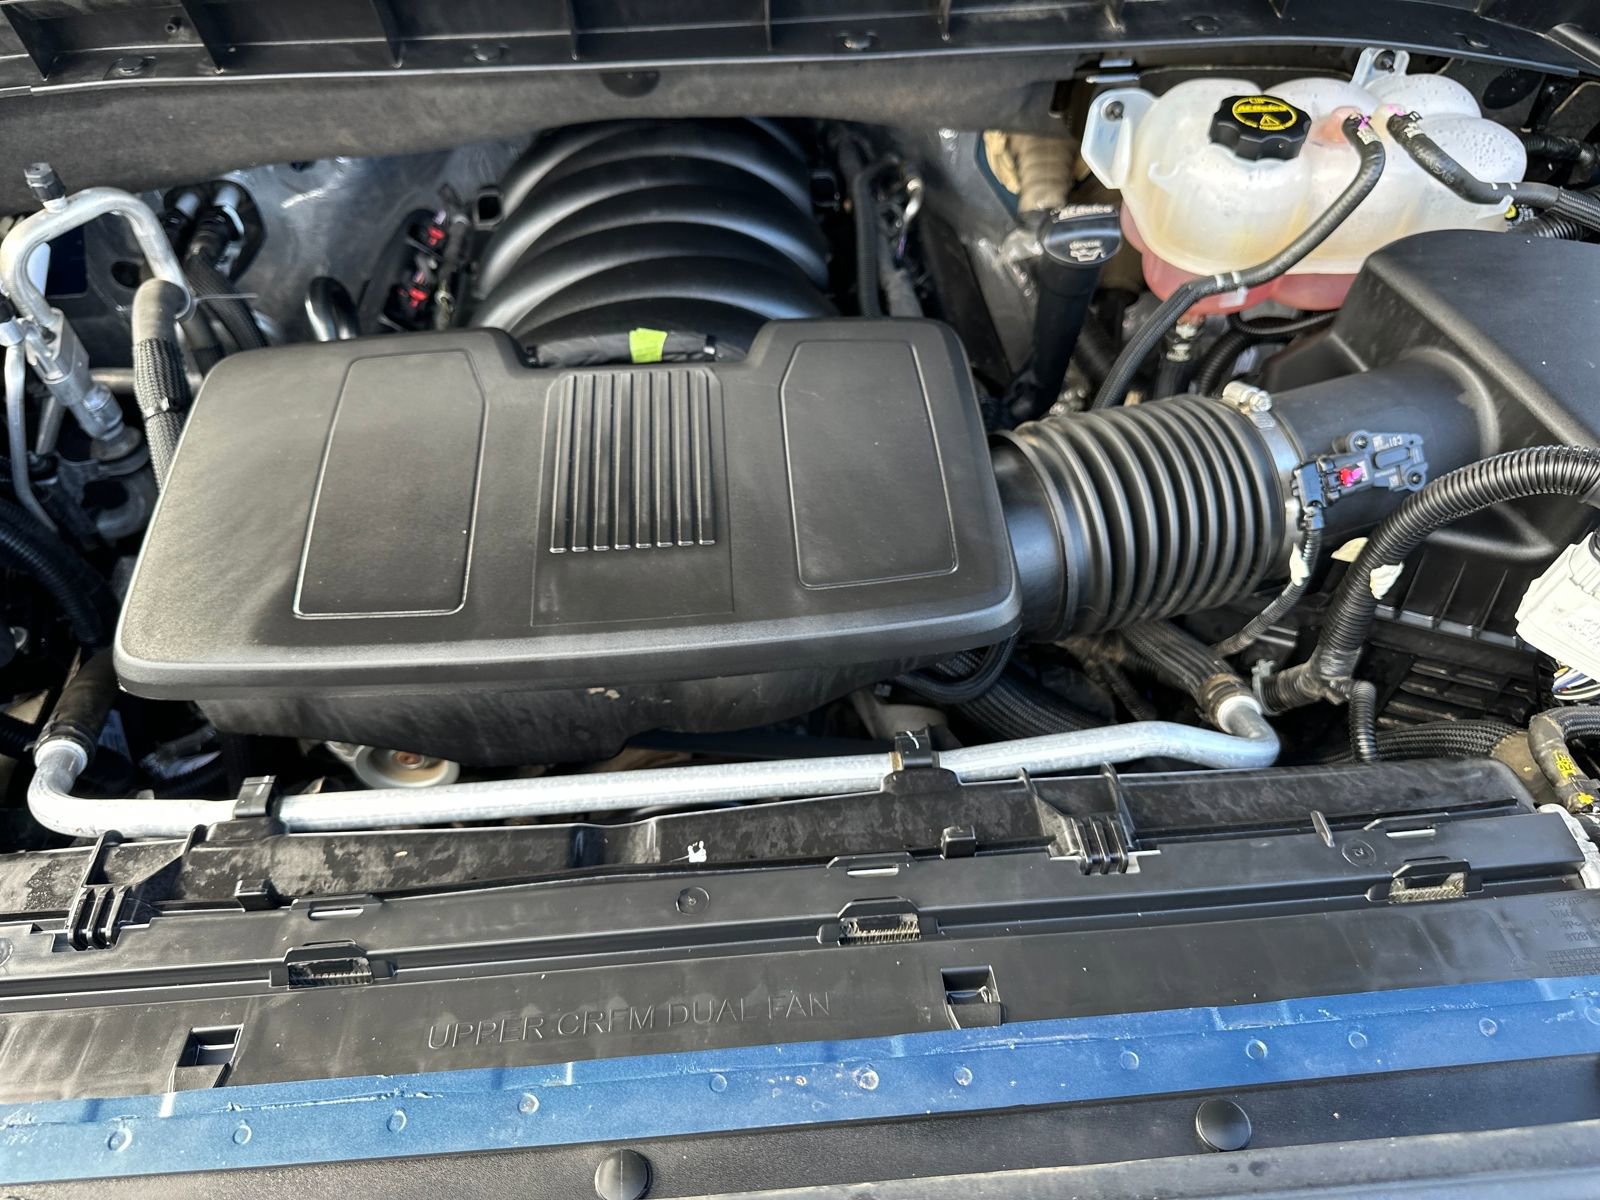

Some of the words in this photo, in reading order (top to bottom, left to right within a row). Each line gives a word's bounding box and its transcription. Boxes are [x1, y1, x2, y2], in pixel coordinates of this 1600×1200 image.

[428, 1017, 545, 1050] UPPER
[556, 1005, 656, 1036] CRFM
[667, 998, 757, 1028] DUAL
[767, 992, 831, 1020] FAN
